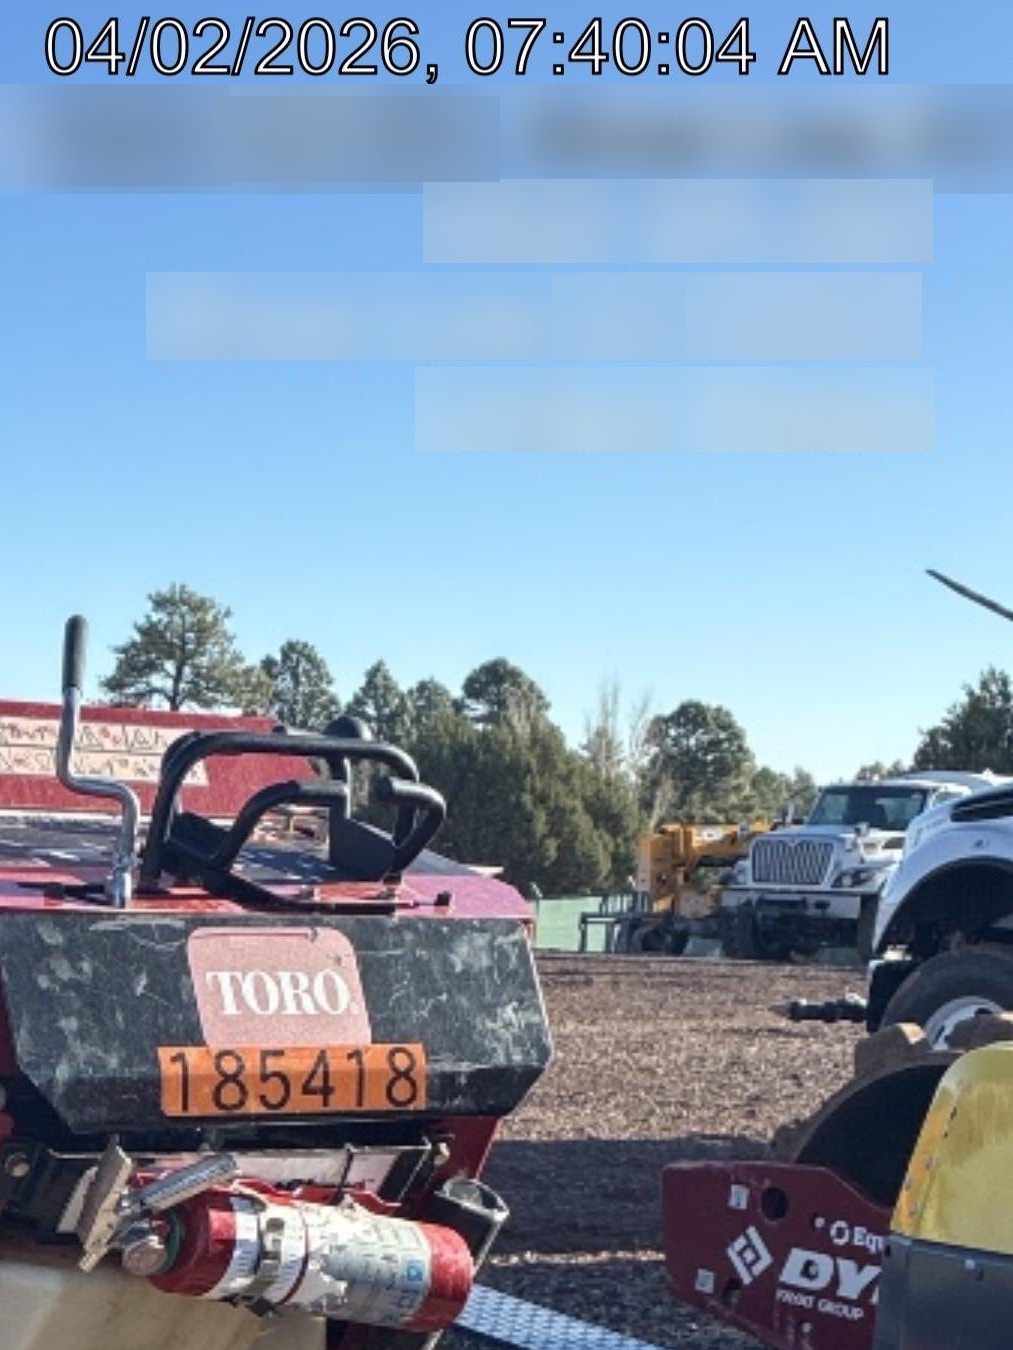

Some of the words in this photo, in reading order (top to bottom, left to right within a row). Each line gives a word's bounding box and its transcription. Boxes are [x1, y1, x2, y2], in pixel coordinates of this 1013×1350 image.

[205, 968, 352, 1016] TORO
[170, 1046, 417, 1113] 185418
[817, 1298, 864, 1319] GROUP
